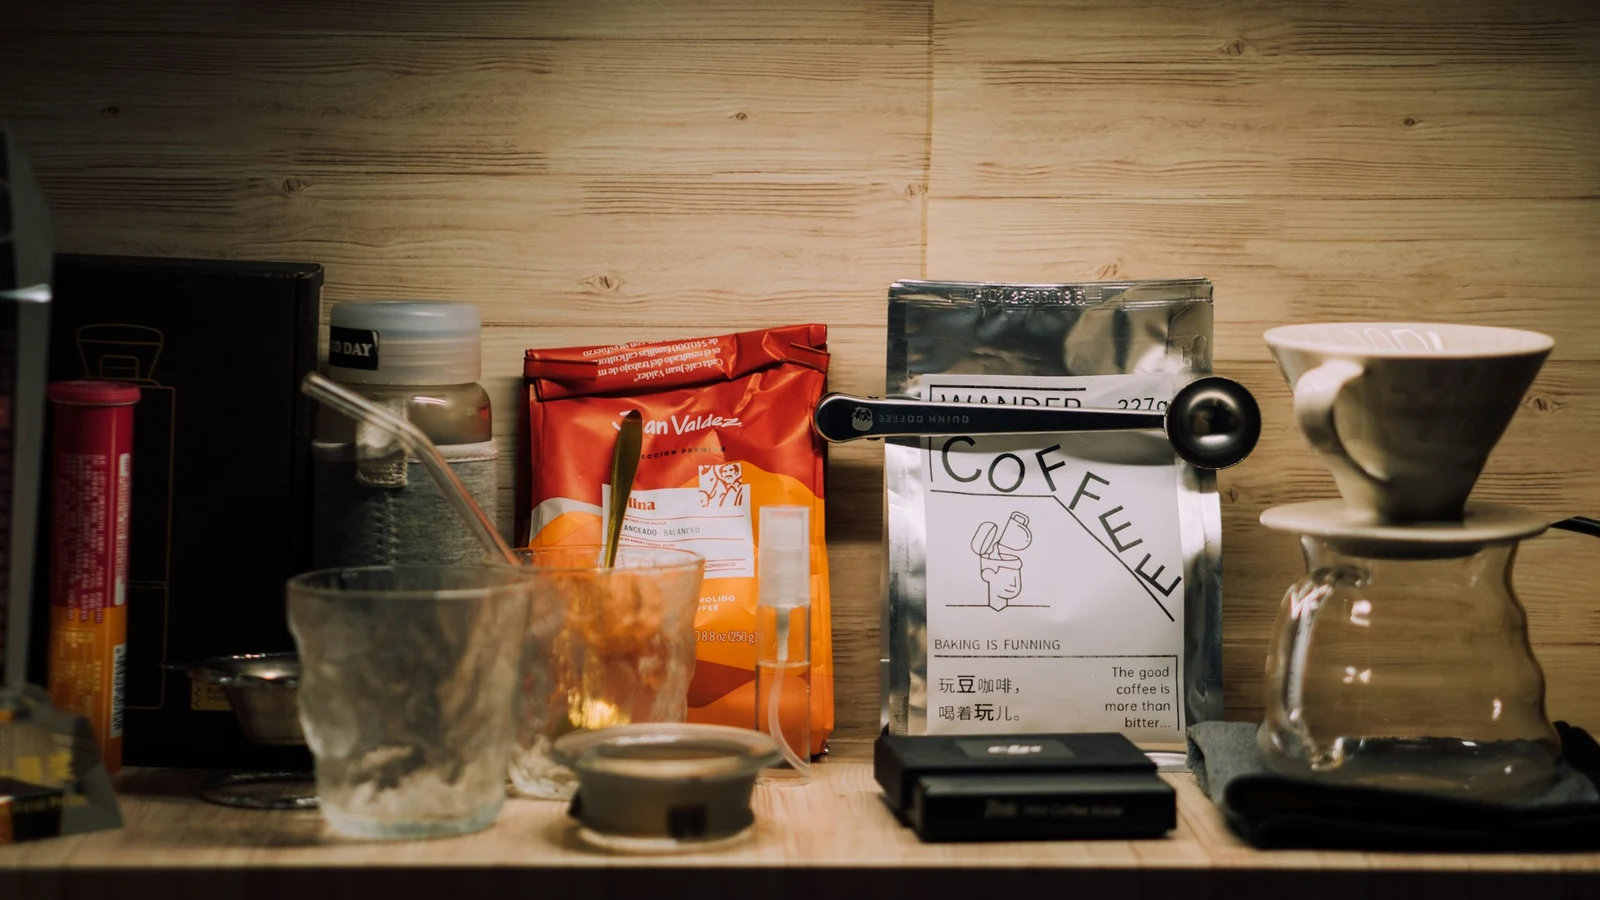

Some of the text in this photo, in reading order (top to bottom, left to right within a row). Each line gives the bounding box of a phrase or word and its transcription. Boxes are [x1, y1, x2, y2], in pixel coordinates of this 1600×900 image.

[671, 339, 708, 352] 540.000
[707, 338, 718, 346] de
[343, 341, 373, 357] DAY
[582, 346, 620, 357] esfuerzo
[638, 345, 671, 357] familias
[703, 349, 711, 357] el
[590, 351, 638, 366] caficultor
[664, 350, 703, 364] resultado
[619, 361, 649, 372] trabajo
[650, 358, 663, 368] del
[685, 361, 702, 372] café
[703, 358, 723, 368] Cada
[608, 367, 619, 376] de
[665, 364, 684, 375] Juan
[612, 410, 742, 436] Jan Valdez
[878, 414, 970, 424] QUINN COFFEE
[628, 497, 656, 511] lina
[941, 435, 1182, 597] COFFEE
[663, 527, 700, 536] BALANCED
[701, 631, 716, 642] 8.8
[716, 633, 726, 642] oz
[728, 630, 747, 643] (250
[934, 639, 1061, 650] BAKING IS FUNNING
[1112, 666, 1170, 681] The good
[1116, 683, 1170, 694] coffee is
[1105, 700, 1170, 712] more than
[1124, 717, 1171, 728] bitter...
